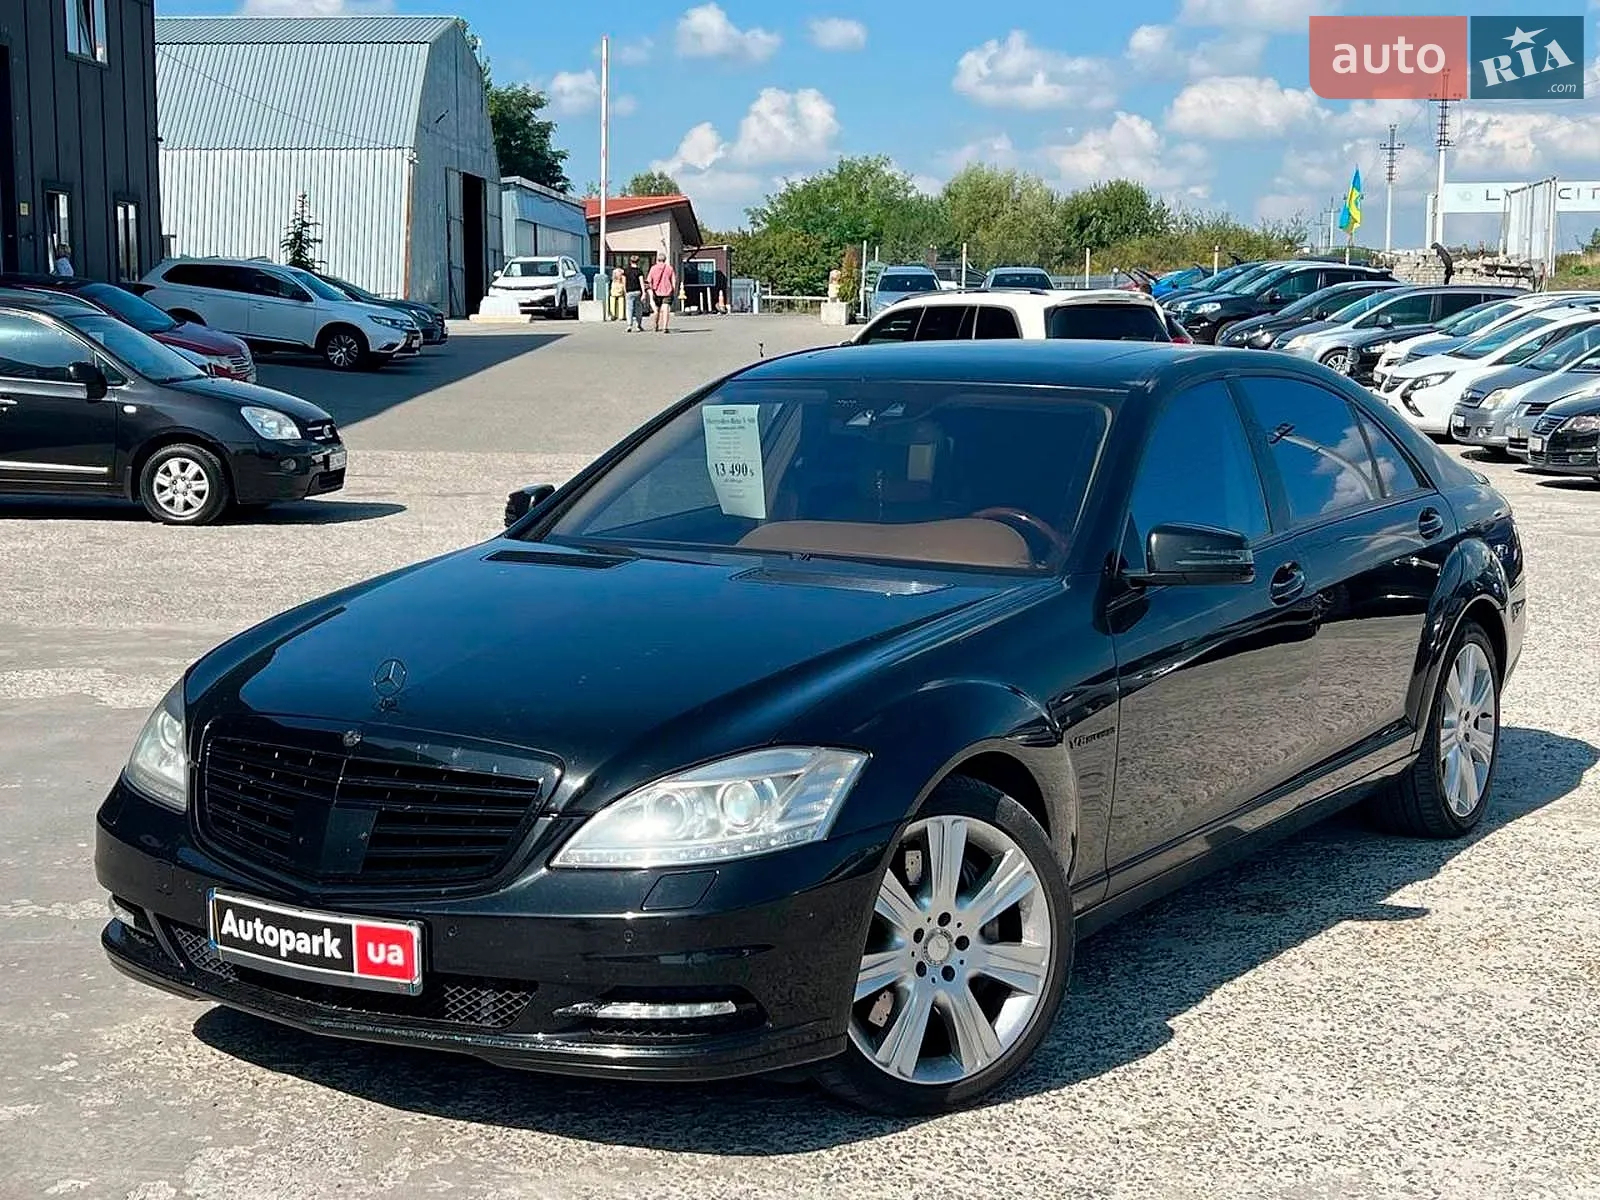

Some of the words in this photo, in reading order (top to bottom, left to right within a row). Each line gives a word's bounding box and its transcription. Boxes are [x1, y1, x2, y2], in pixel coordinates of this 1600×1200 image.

[714, 462, 726, 477] 13
[729, 462, 748, 477] 490
[221, 908, 343, 959] Autopark
[366, 942, 405, 966] ua
